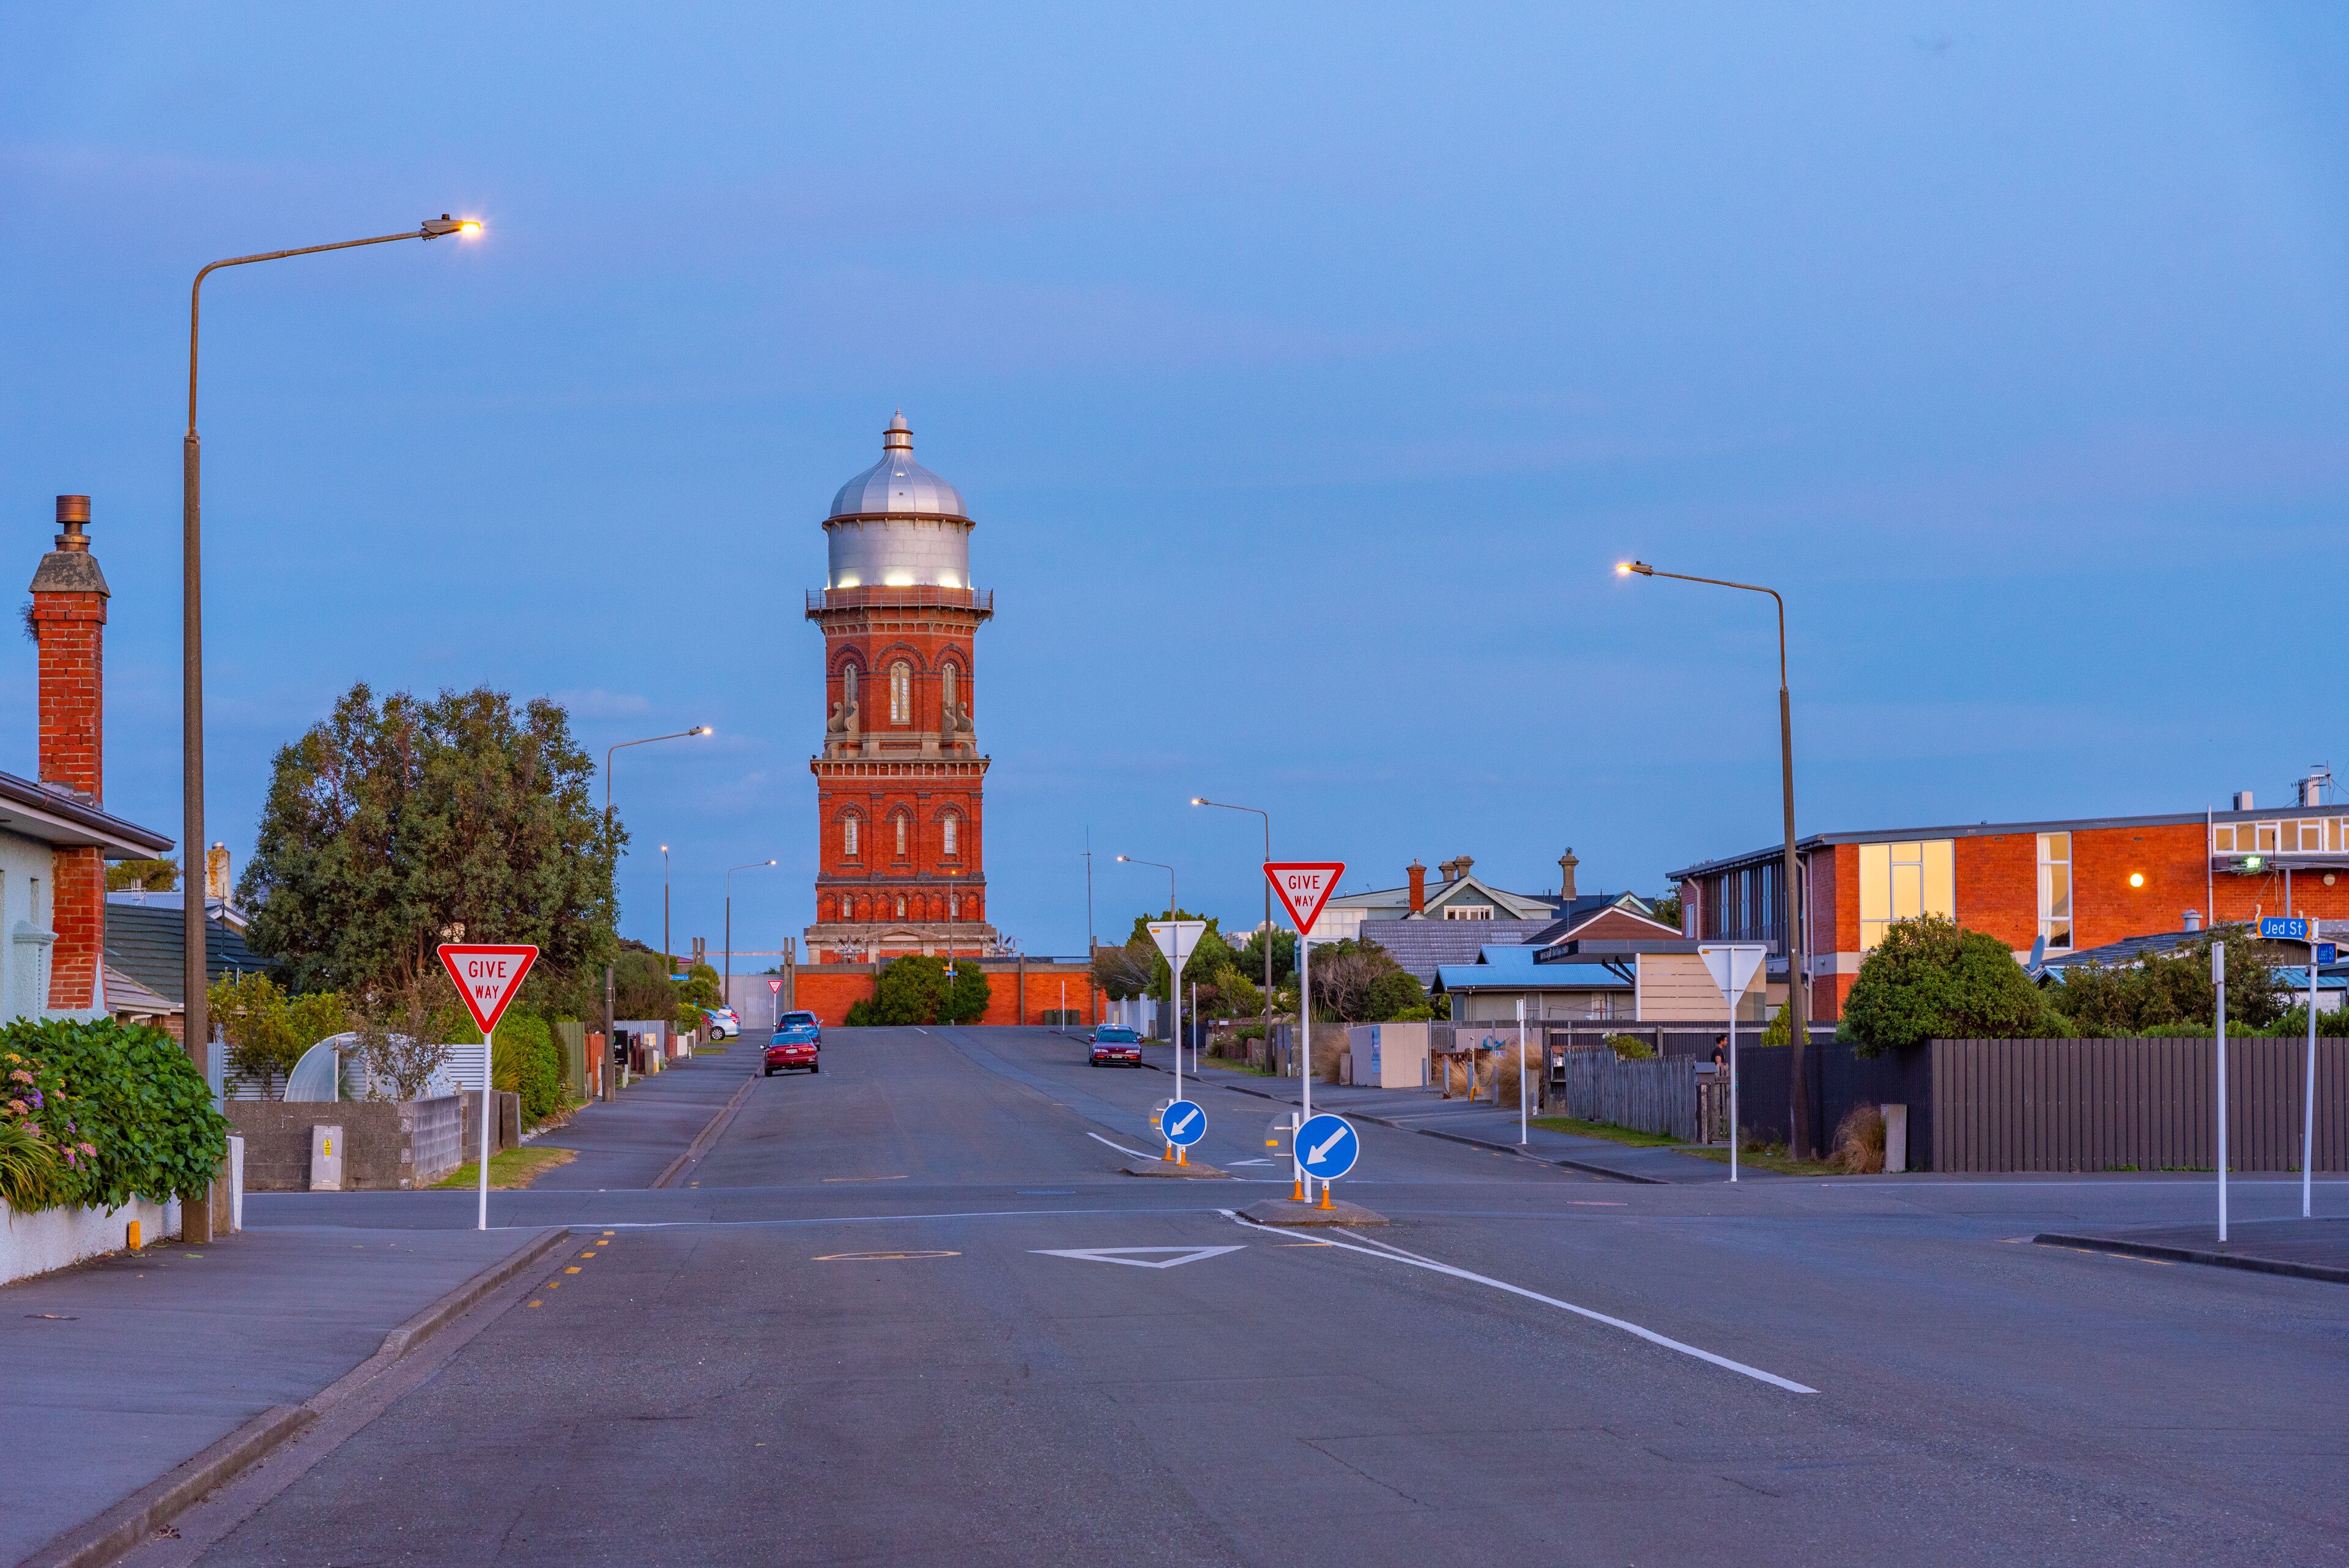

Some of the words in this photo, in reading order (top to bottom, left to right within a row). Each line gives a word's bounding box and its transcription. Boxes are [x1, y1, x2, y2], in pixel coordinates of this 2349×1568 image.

[1288, 875, 1320, 890] GIVE
[1294, 895, 1314, 907] WAY
[2265, 920, 2285, 935] Jed
[2289, 921, 2303, 935] St
[2318, 948, 2328, 961] Leet
[2328, 946, 2334, 960] St
[469, 960, 507, 978] GIVE
[475, 985, 499, 999] WAY
